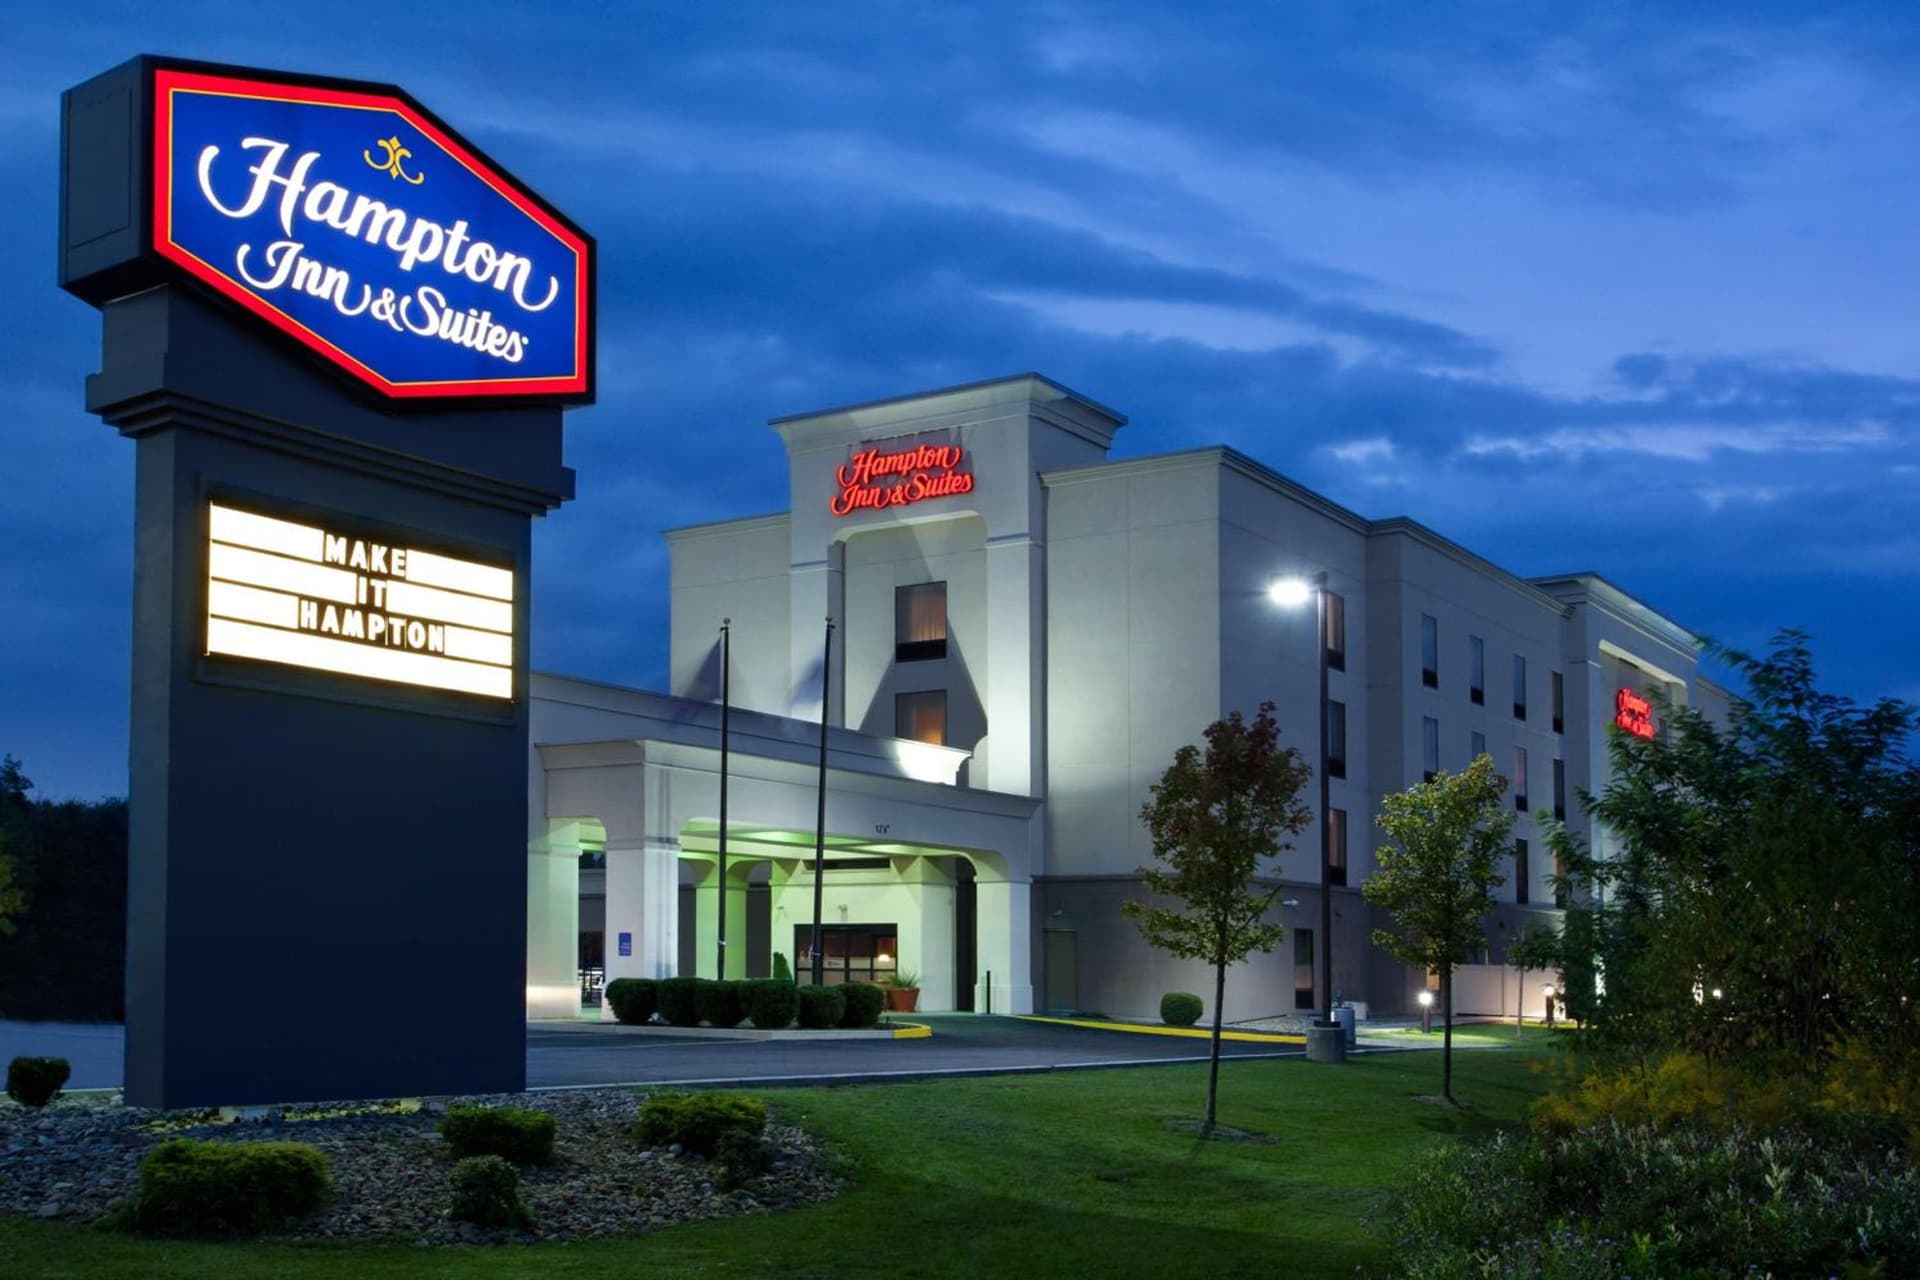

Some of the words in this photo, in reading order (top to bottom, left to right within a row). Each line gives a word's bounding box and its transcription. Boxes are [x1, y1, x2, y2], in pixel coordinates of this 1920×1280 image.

[198, 137, 559, 312] Hampton
[236, 240, 371, 316] Inn
[399, 286, 527, 363] Suites
[837, 445, 962, 488] Hampton
[830, 484, 892, 516] Inn
[904, 471, 974, 501] Suites
[324, 532, 407, 577] MAKE
[357, 576, 388, 609] IT
[299, 598, 444, 653] HAMPTON
